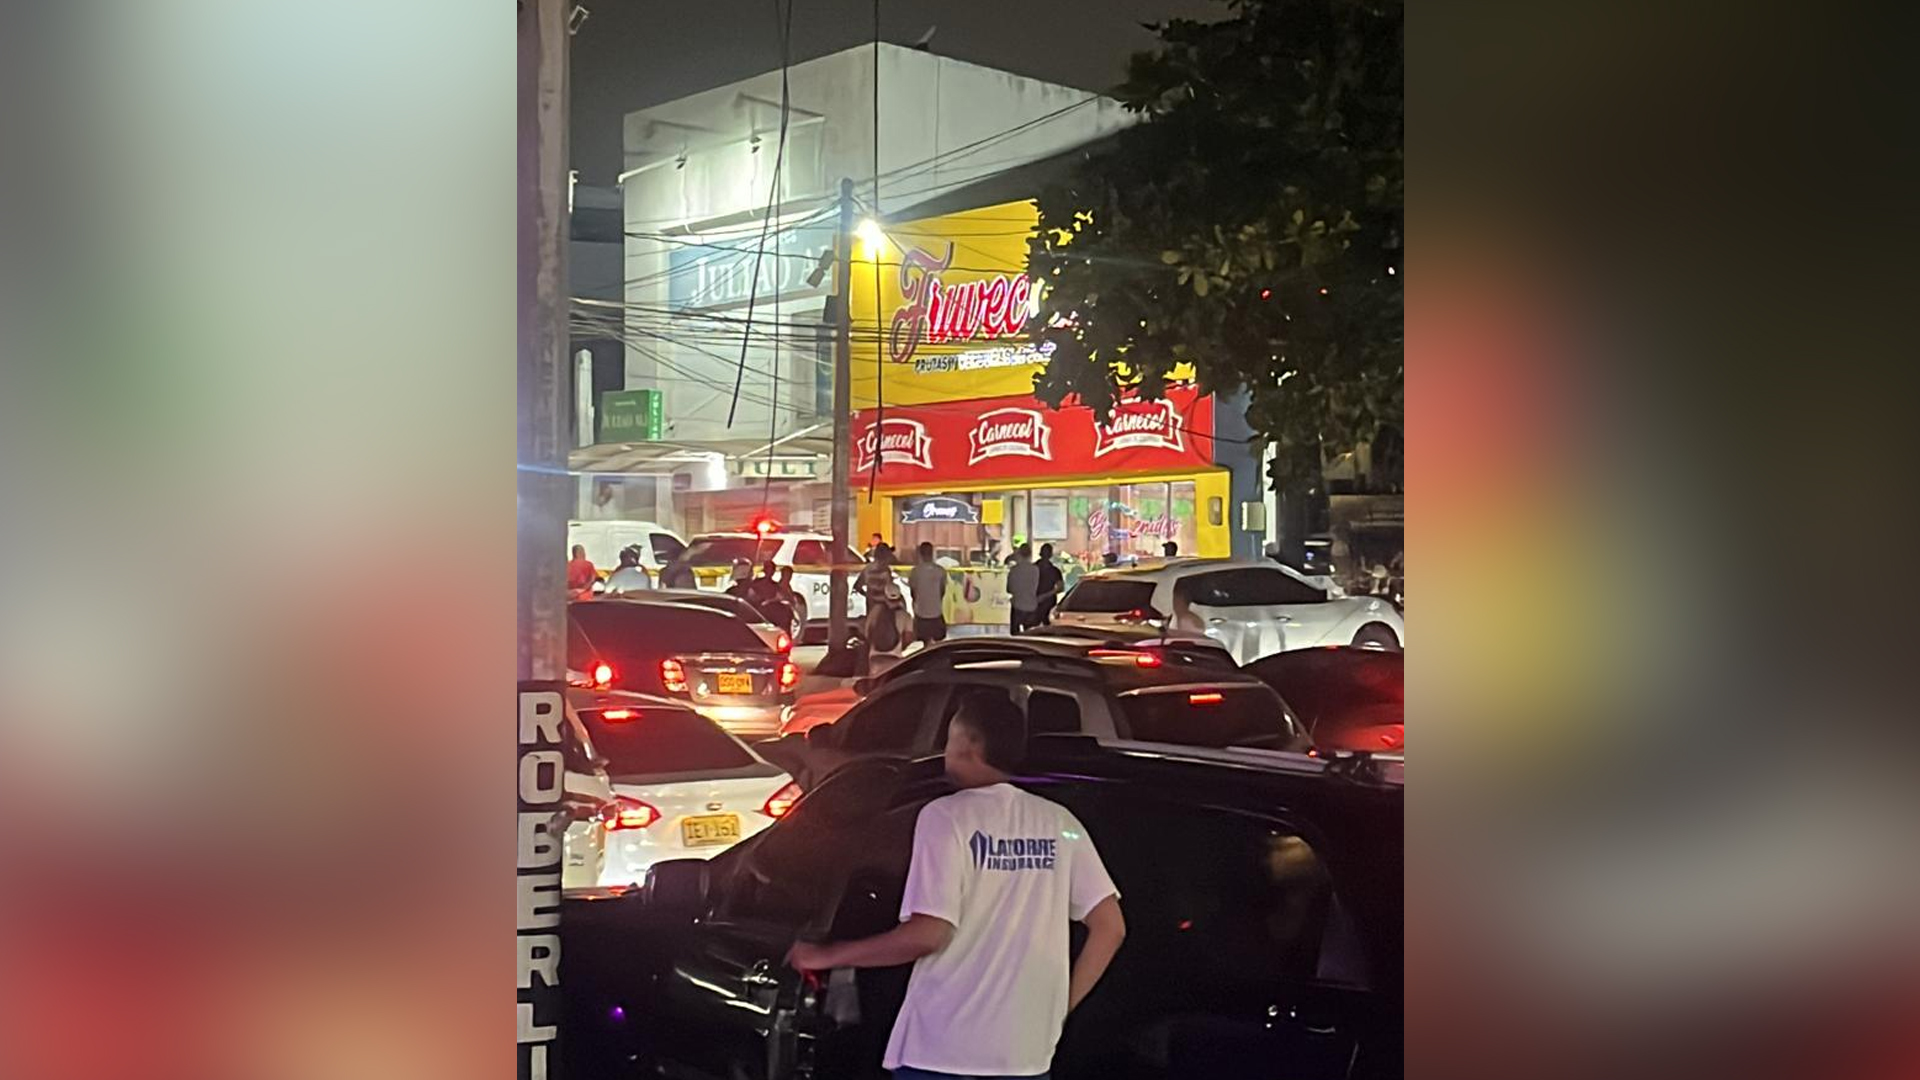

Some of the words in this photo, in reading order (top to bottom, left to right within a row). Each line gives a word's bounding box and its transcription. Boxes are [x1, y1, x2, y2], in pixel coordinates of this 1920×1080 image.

[890, 240, 1032, 363] Fruvec
[978, 418, 1032, 445] Carnecol
[731, 459, 832, 476] JULI
